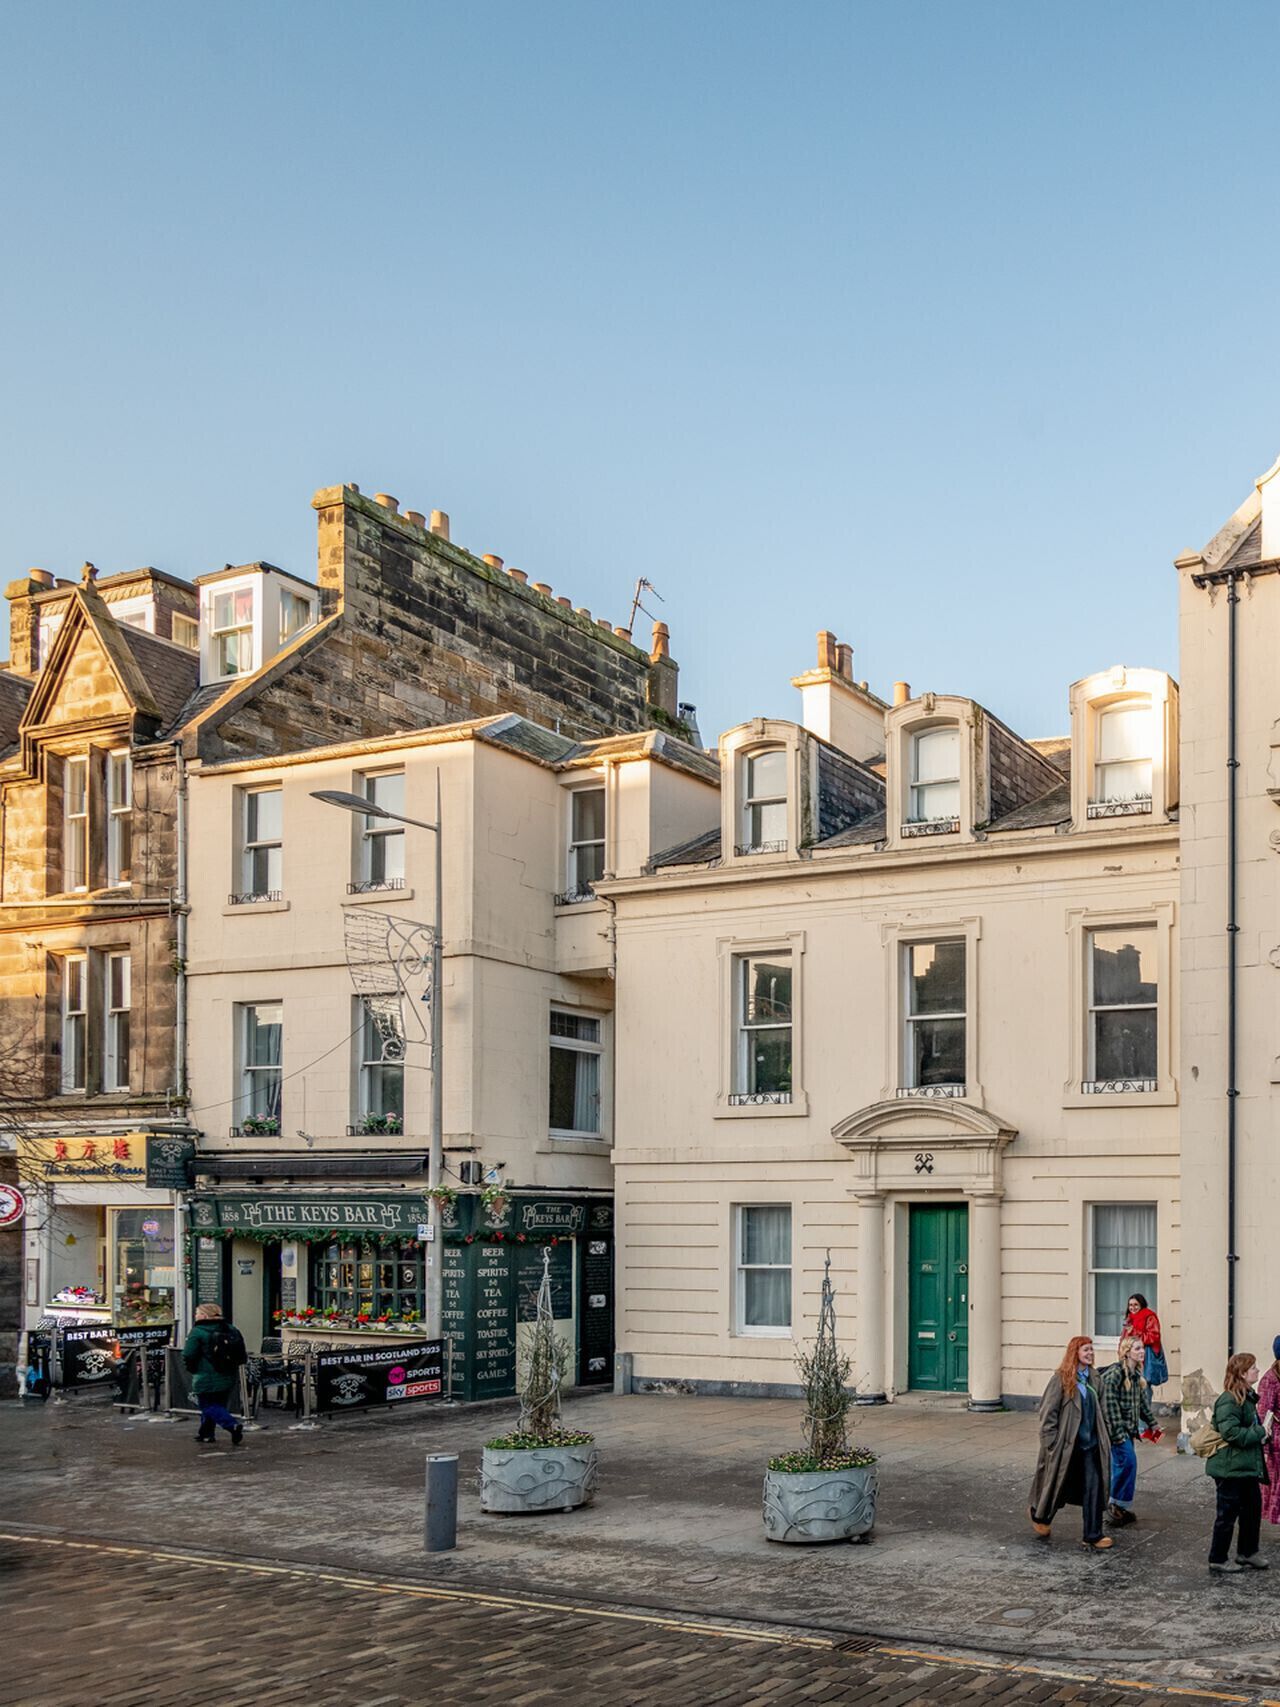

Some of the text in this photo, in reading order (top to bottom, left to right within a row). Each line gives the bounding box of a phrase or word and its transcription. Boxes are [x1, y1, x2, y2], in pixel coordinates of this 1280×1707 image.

[222, 1212, 239, 1222] 1858
[264, 1206, 377, 1222] THE KEYS BAR
[407, 1213, 427, 1223] 1858
[536, 1214, 571, 1224] KEYS BAR
[482, 1248, 504, 1257] BEER
[477, 1268, 508, 1278] SPIRITS
[445, 1289, 460, 1298] TEA
[483, 1288, 502, 1298] TEA
[477, 1309, 508, 1318] COFFEE
[67, 1332, 88, 1341] BEST
[89, 1330, 108, 1339] BAR
[477, 1330, 509, 1339] TOASTIES
[320, 1356, 343, 1366] BEST
[344, 1354, 362, 1364] BAR
[363, 1353, 374, 1361] IN
[375, 1347, 420, 1360] SCOTLAND
[420, 1345, 440, 1355] 2025
[476, 1349, 509, 1360] SKY SPORTS
[406, 1366, 441, 1379] SPORTS
[476, 1369, 508, 1380] GAMES
[406, 1382, 439, 1395] sports
